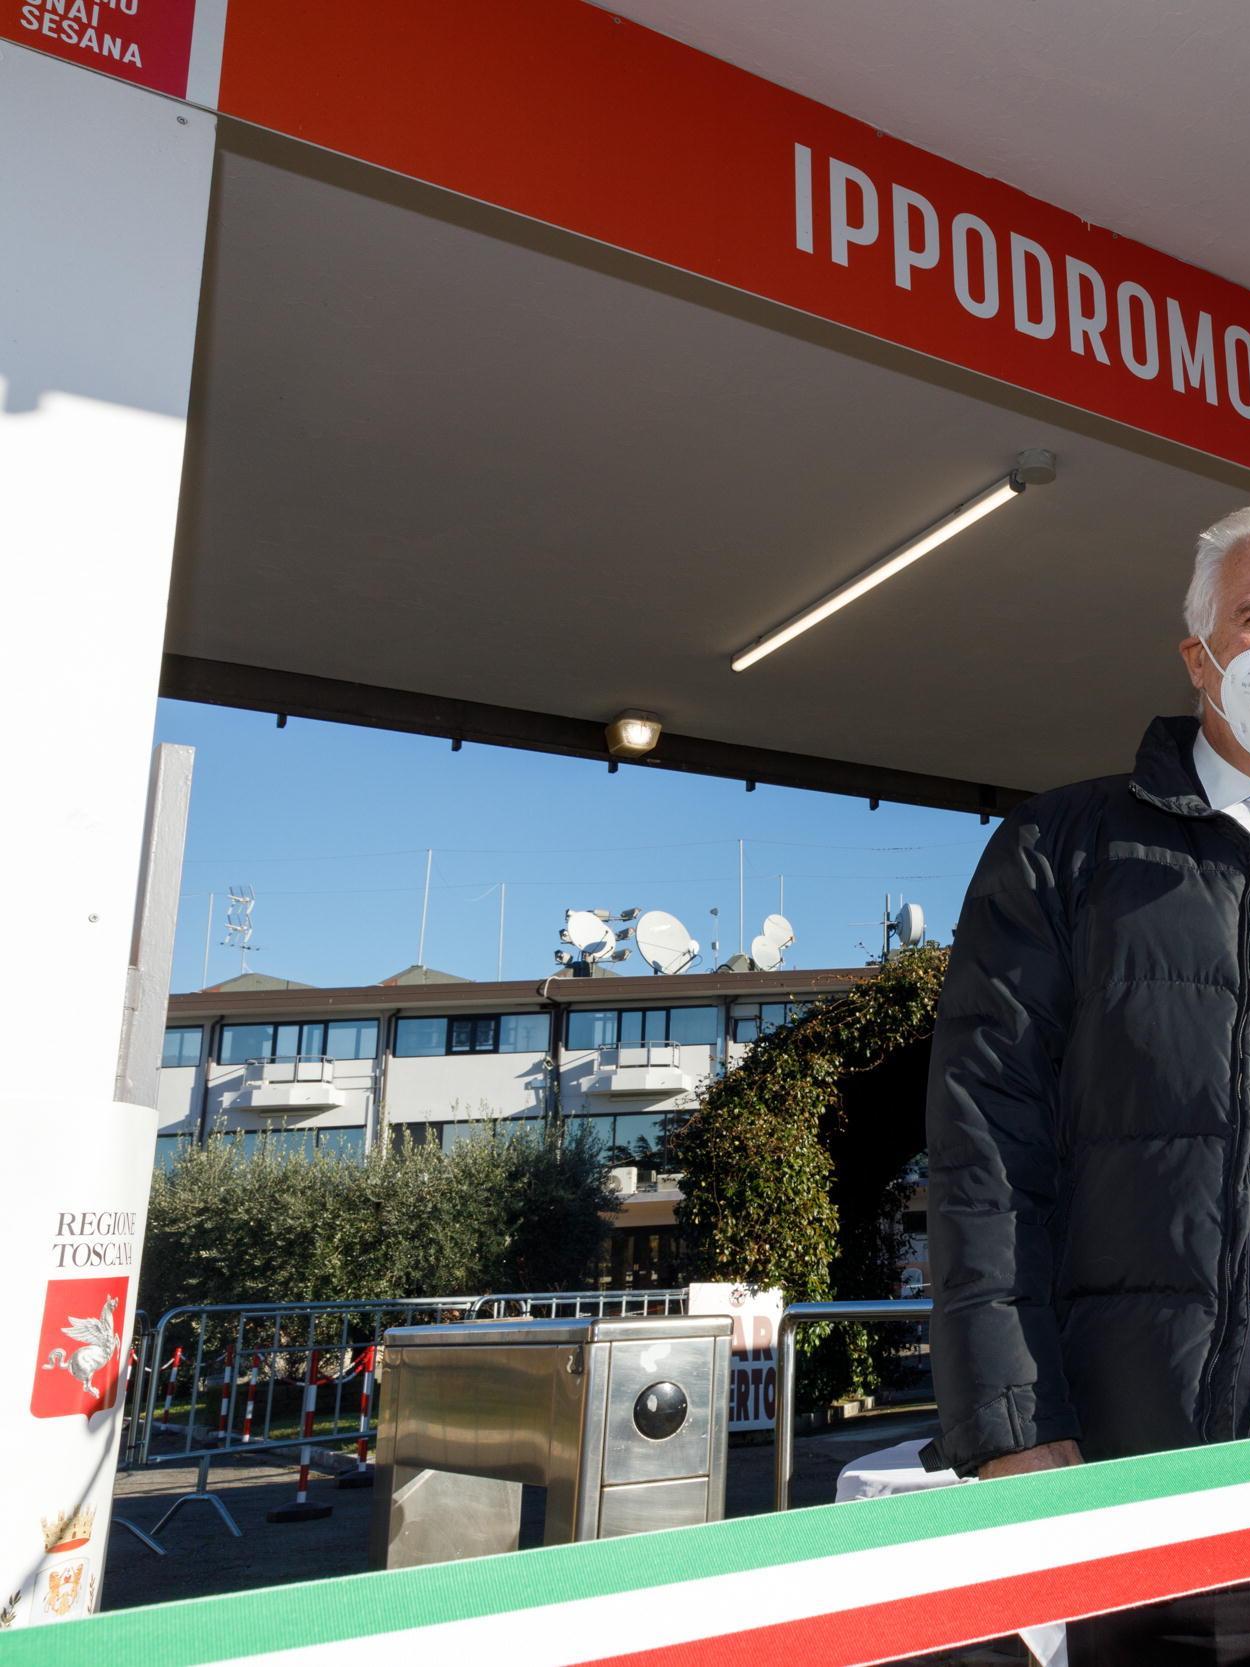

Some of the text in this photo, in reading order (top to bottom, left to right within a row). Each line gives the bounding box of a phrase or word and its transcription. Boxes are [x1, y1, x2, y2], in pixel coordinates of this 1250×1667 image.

[25, 0, 100, 27] NAI
[20, 5, 143, 68] SESANA
[55, 1212, 137, 1236] REGIONE
[52, 1242, 132, 1268] TOSCANA
[731, 1315, 773, 1362] AR
